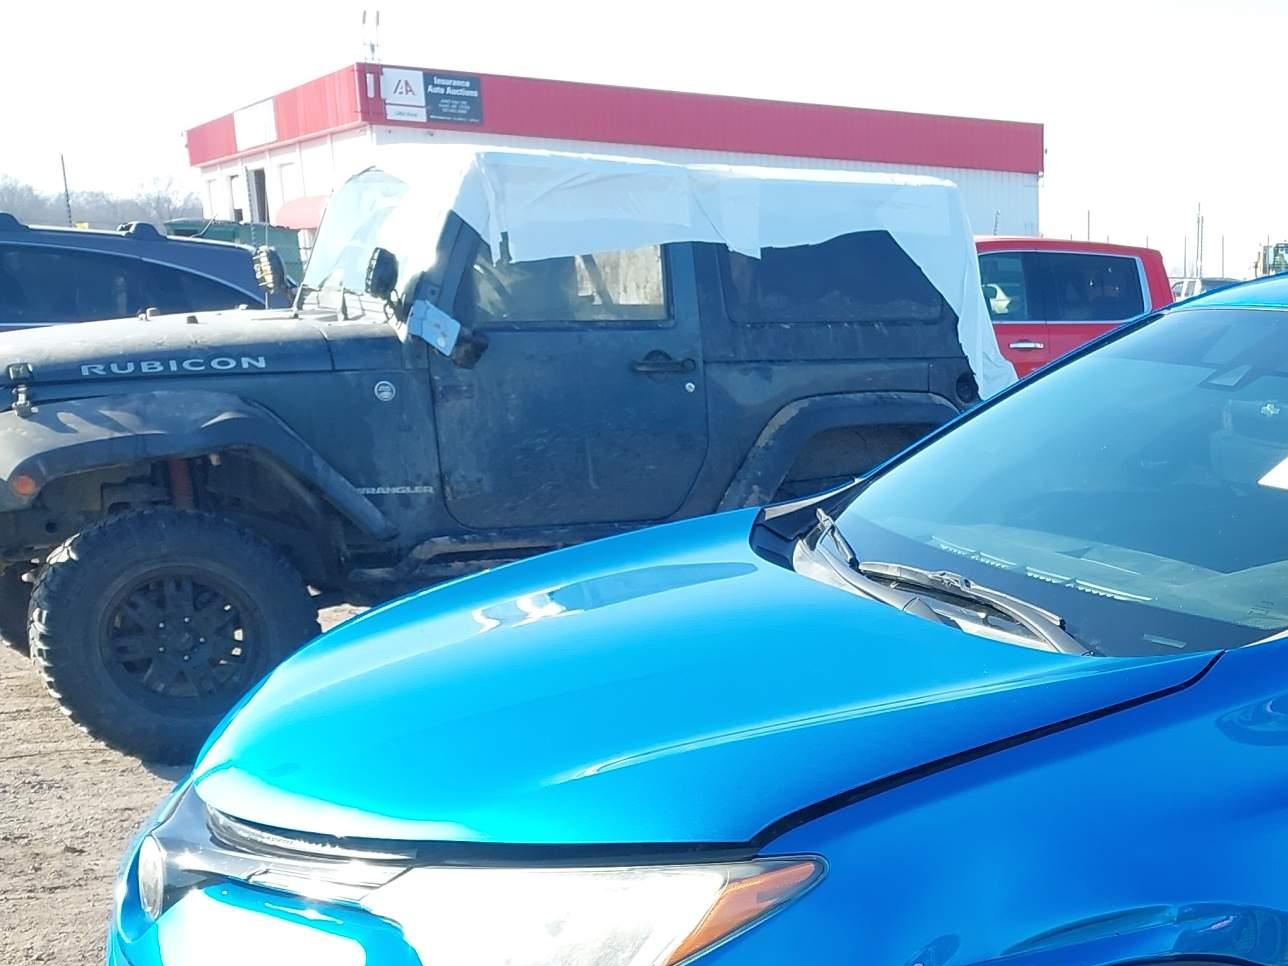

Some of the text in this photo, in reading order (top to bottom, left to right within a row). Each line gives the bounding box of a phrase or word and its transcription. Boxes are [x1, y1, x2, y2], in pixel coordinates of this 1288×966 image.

[433, 76, 470, 88] Insurance
[427, 85, 479, 98] Auto Auctions
[80, 355, 267, 377] RUBICON
